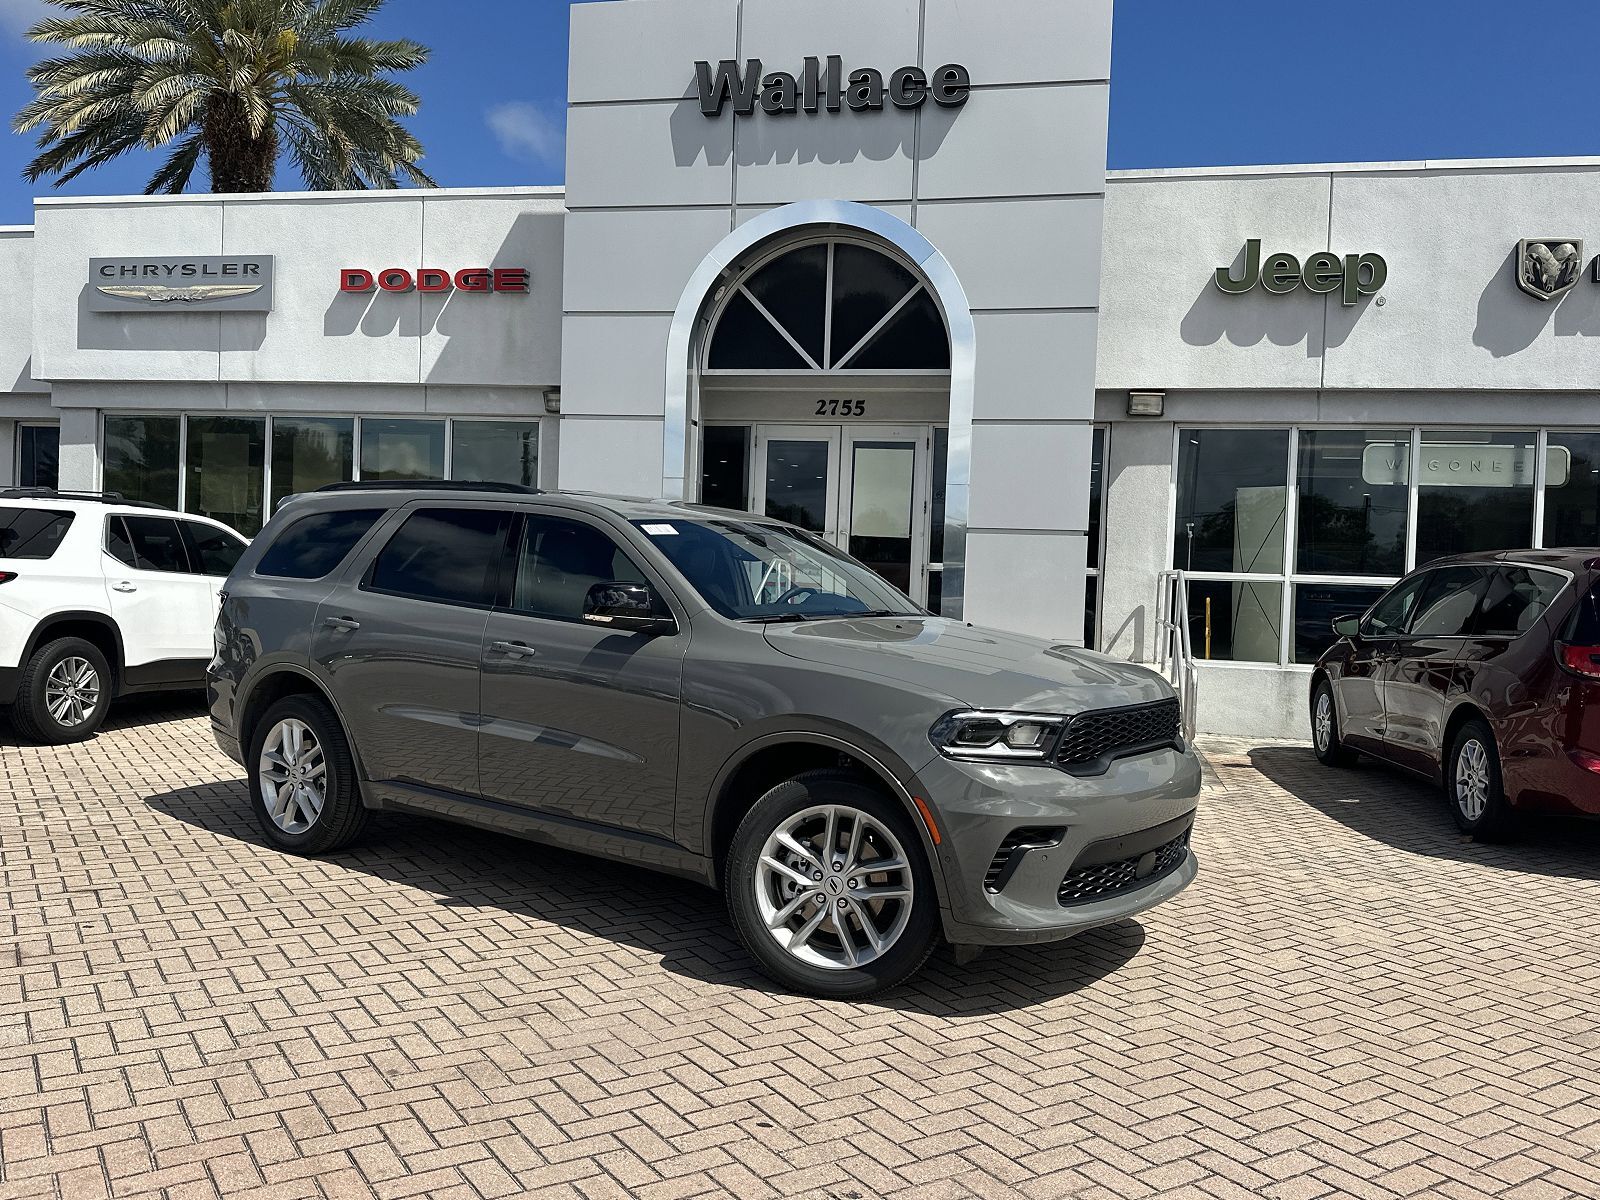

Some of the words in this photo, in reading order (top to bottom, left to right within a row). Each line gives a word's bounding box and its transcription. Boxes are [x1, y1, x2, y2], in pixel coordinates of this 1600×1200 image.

[694, 54, 971, 116] Wallace
[100, 263, 260, 277] CHRYSLER
[1215, 239, 1388, 306] Jeep
[340, 268, 530, 294] DODGE
[815, 399, 866, 416] 2755
[1385, 458, 1525, 473] WGONEE
